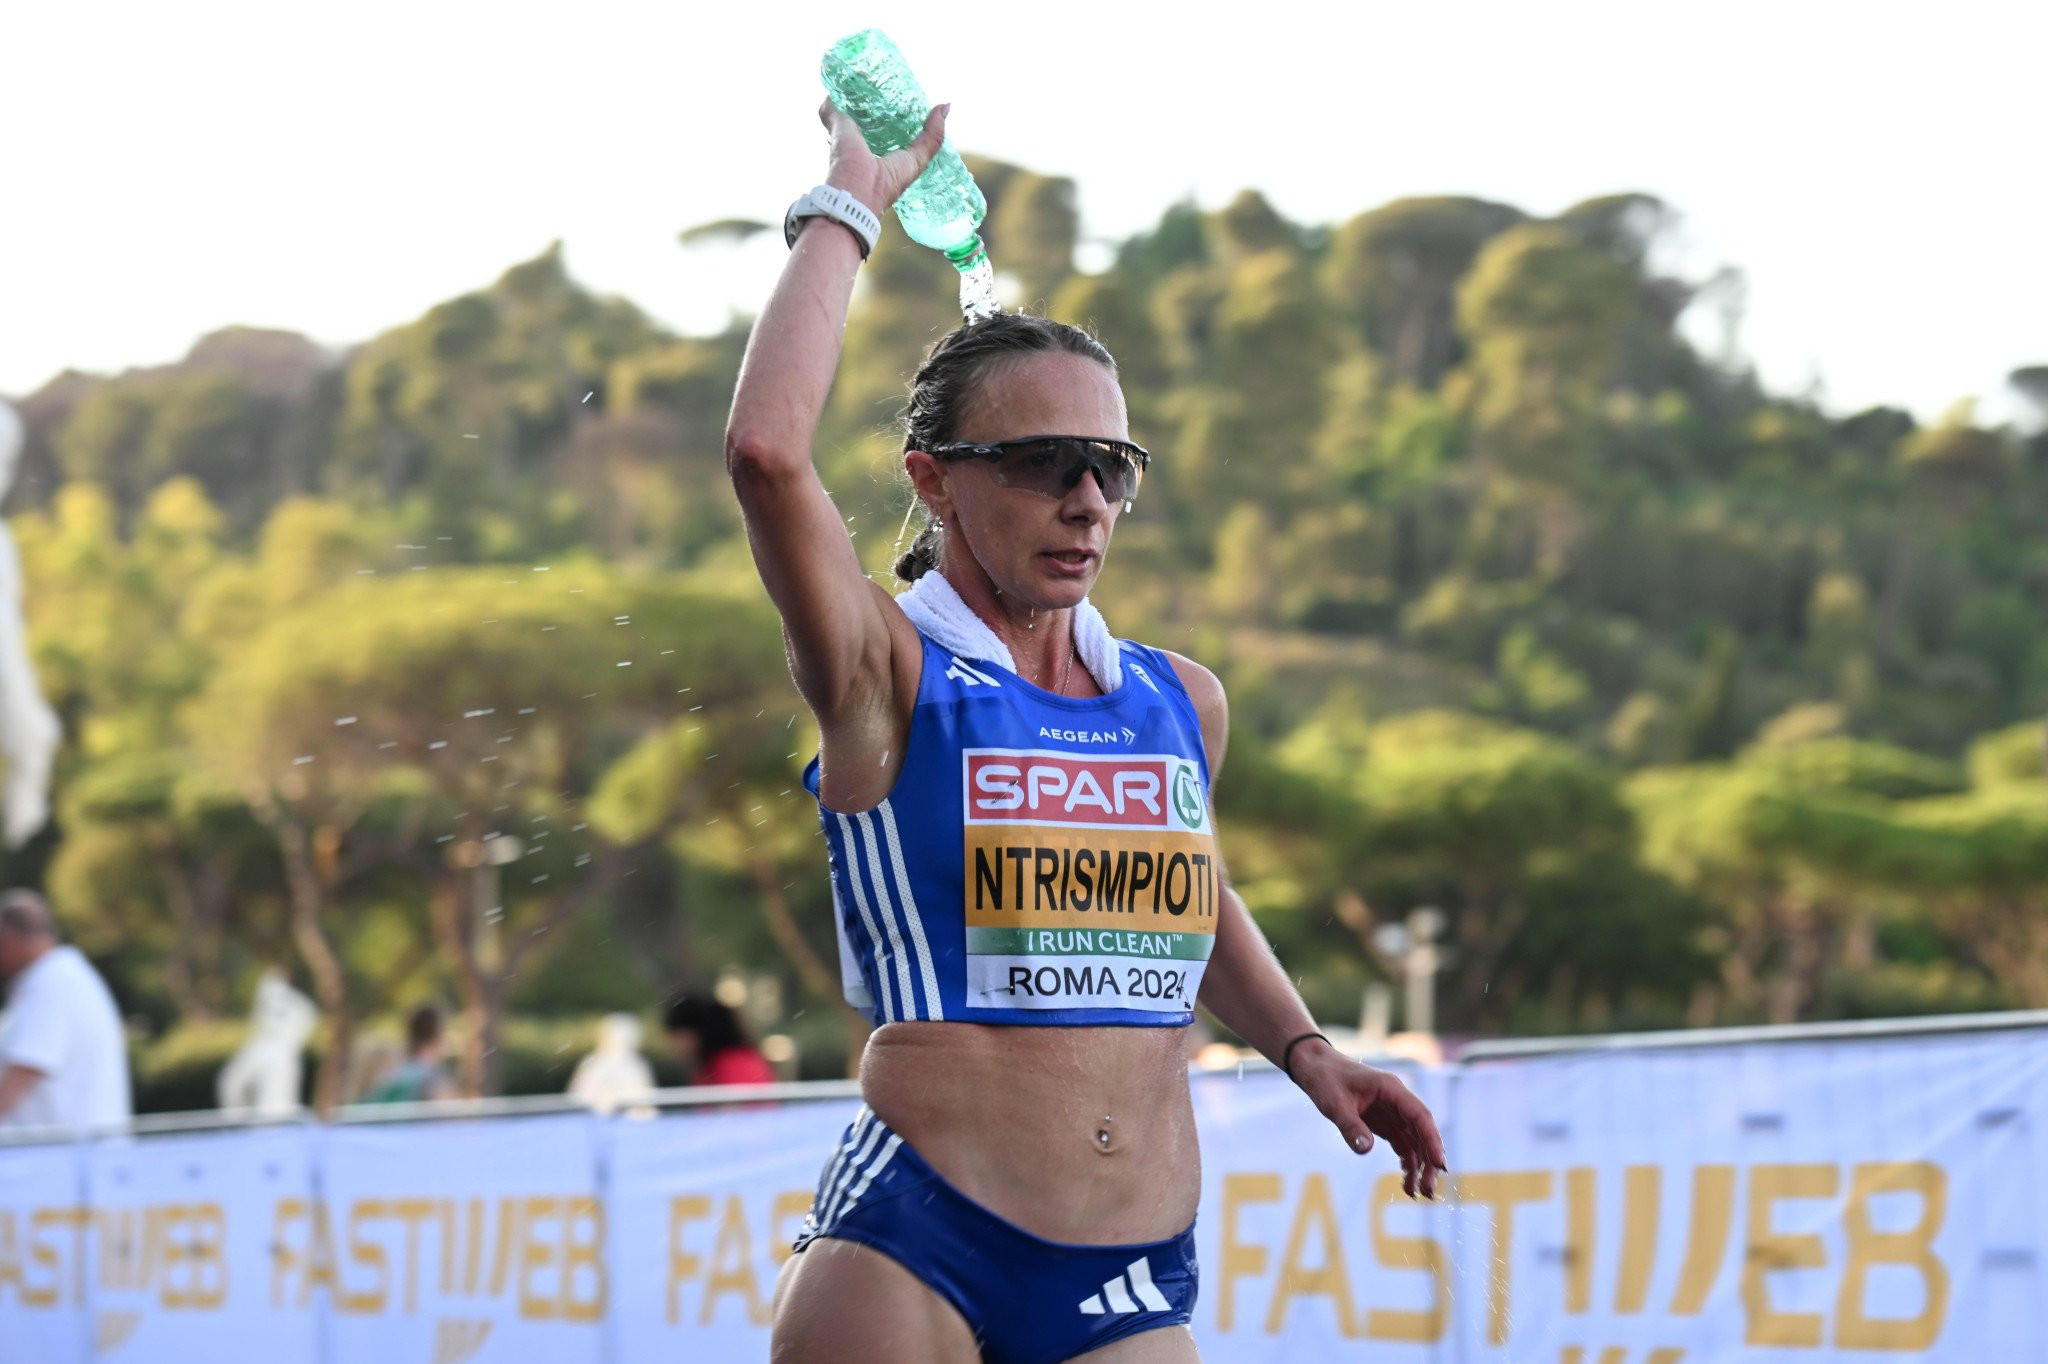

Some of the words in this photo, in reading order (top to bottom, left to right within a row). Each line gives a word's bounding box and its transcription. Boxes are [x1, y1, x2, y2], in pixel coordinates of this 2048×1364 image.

[1039, 727, 1118, 744] AEGEAN
[975, 764, 1161, 816] SPAR
[975, 847, 1212, 917] NTRISMPIOTI
[1028, 931, 1034, 952] I
[1039, 931, 1094, 952] RUN
[1009, 966, 1121, 997] ROMA
[1127, 967, 1187, 999] 2024
[0, 1204, 227, 1312] ASTWEB
[271, 1195, 609, 1321] FASTWEB
[1214, 1161, 1950, 1350] FASTWEB
